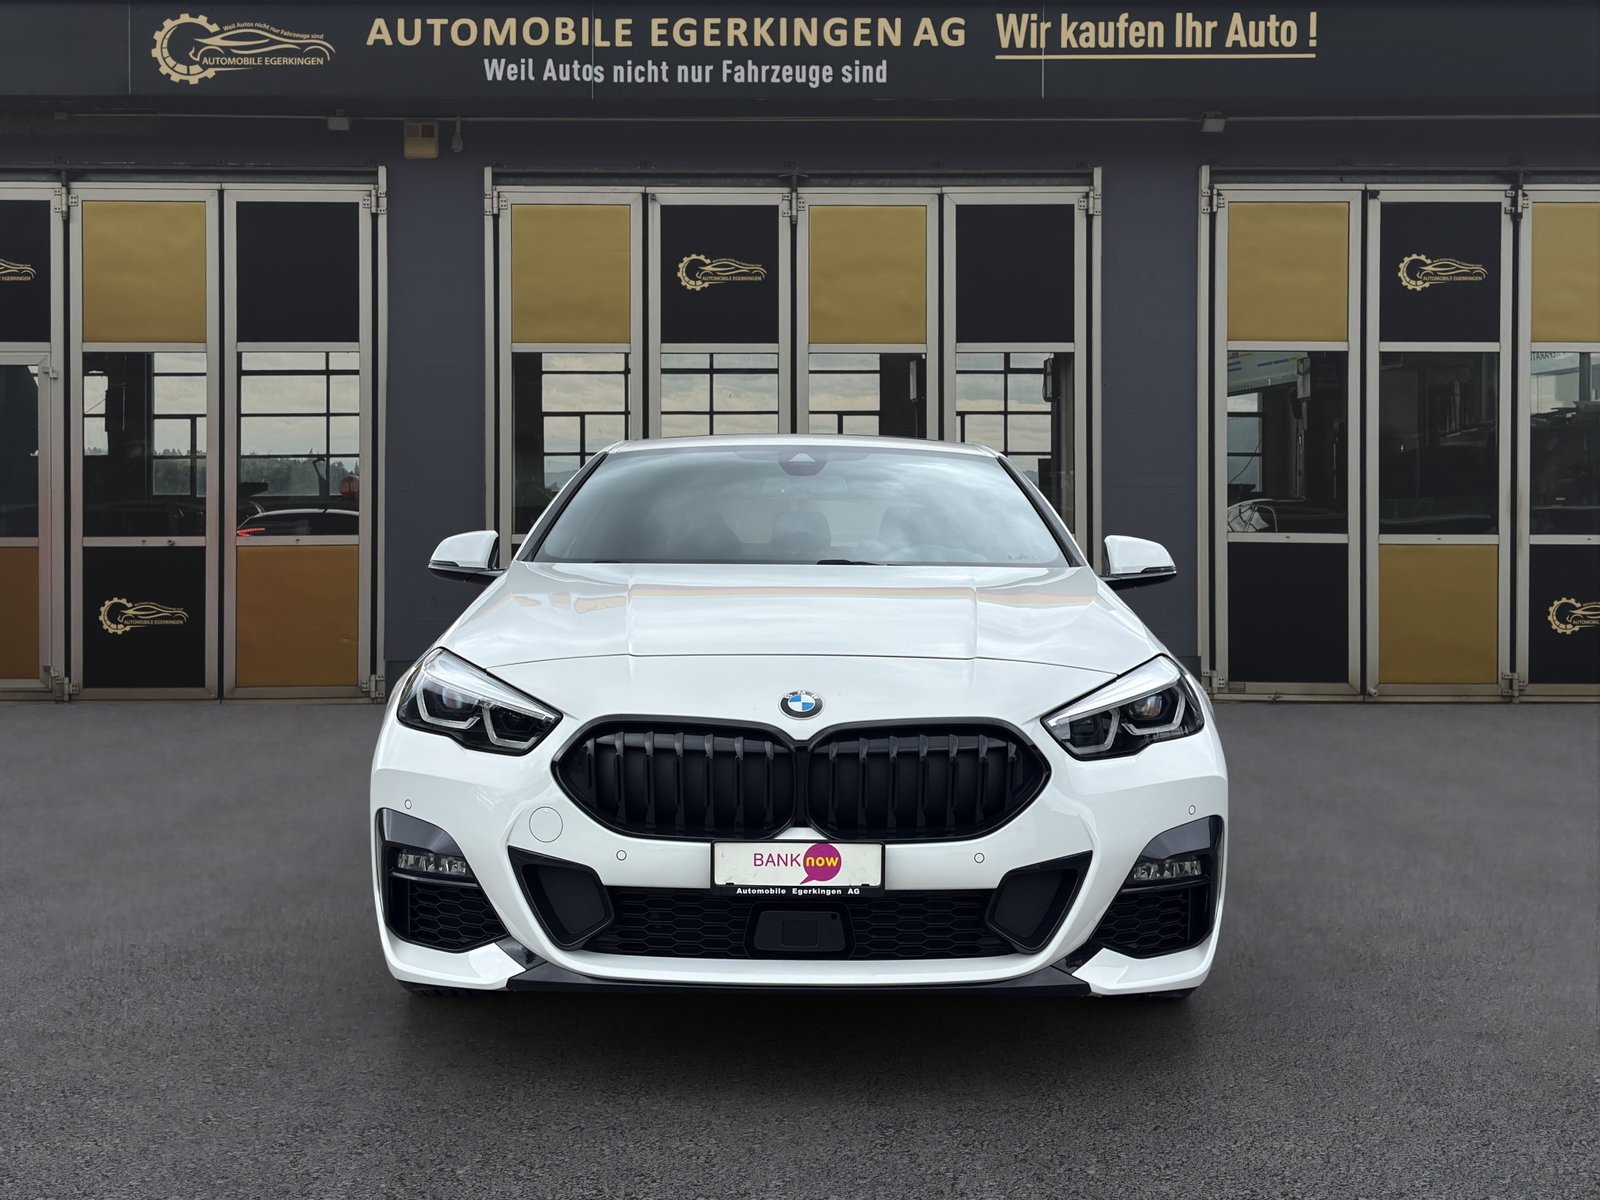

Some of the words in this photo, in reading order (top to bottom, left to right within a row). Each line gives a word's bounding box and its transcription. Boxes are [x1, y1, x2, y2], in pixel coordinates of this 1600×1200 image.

[222, 23, 236, 31] Weil
[254, 21, 270, 31] nicht
[269, 26, 281, 34] nur
[280, 29, 310, 39] Fahrzeuge
[366, 16, 633, 47] AUTOMOBILE
[650, 16, 902, 47] EGERKINGEN
[913, 16, 966, 47] AG
[995, 12, 1051, 49] Wir
[1060, 12, 1164, 49] kaufen
[1175, 12, 1218, 48] Ihr
[1225, 11, 1298, 48] Auto
[1308, 11, 1318, 47] !
[202, 57, 262, 66] AUTOMOBILE
[264, 56, 324, 66] EGERKINGEN
[483, 58, 535, 81] Weil
[543, 58, 605, 83] Autos
[612, 60, 669, 83] nicht
[677, 63, 714, 83] nur
[722, 59, 834, 89] Fahrzeuge
[841, 59, 888, 84] sind
[753, 853, 801, 867] BANK
[805, 856, 839, 867] now
[736, 887, 786, 895] Automobile
[792, 887, 842, 896] Egerkingen
